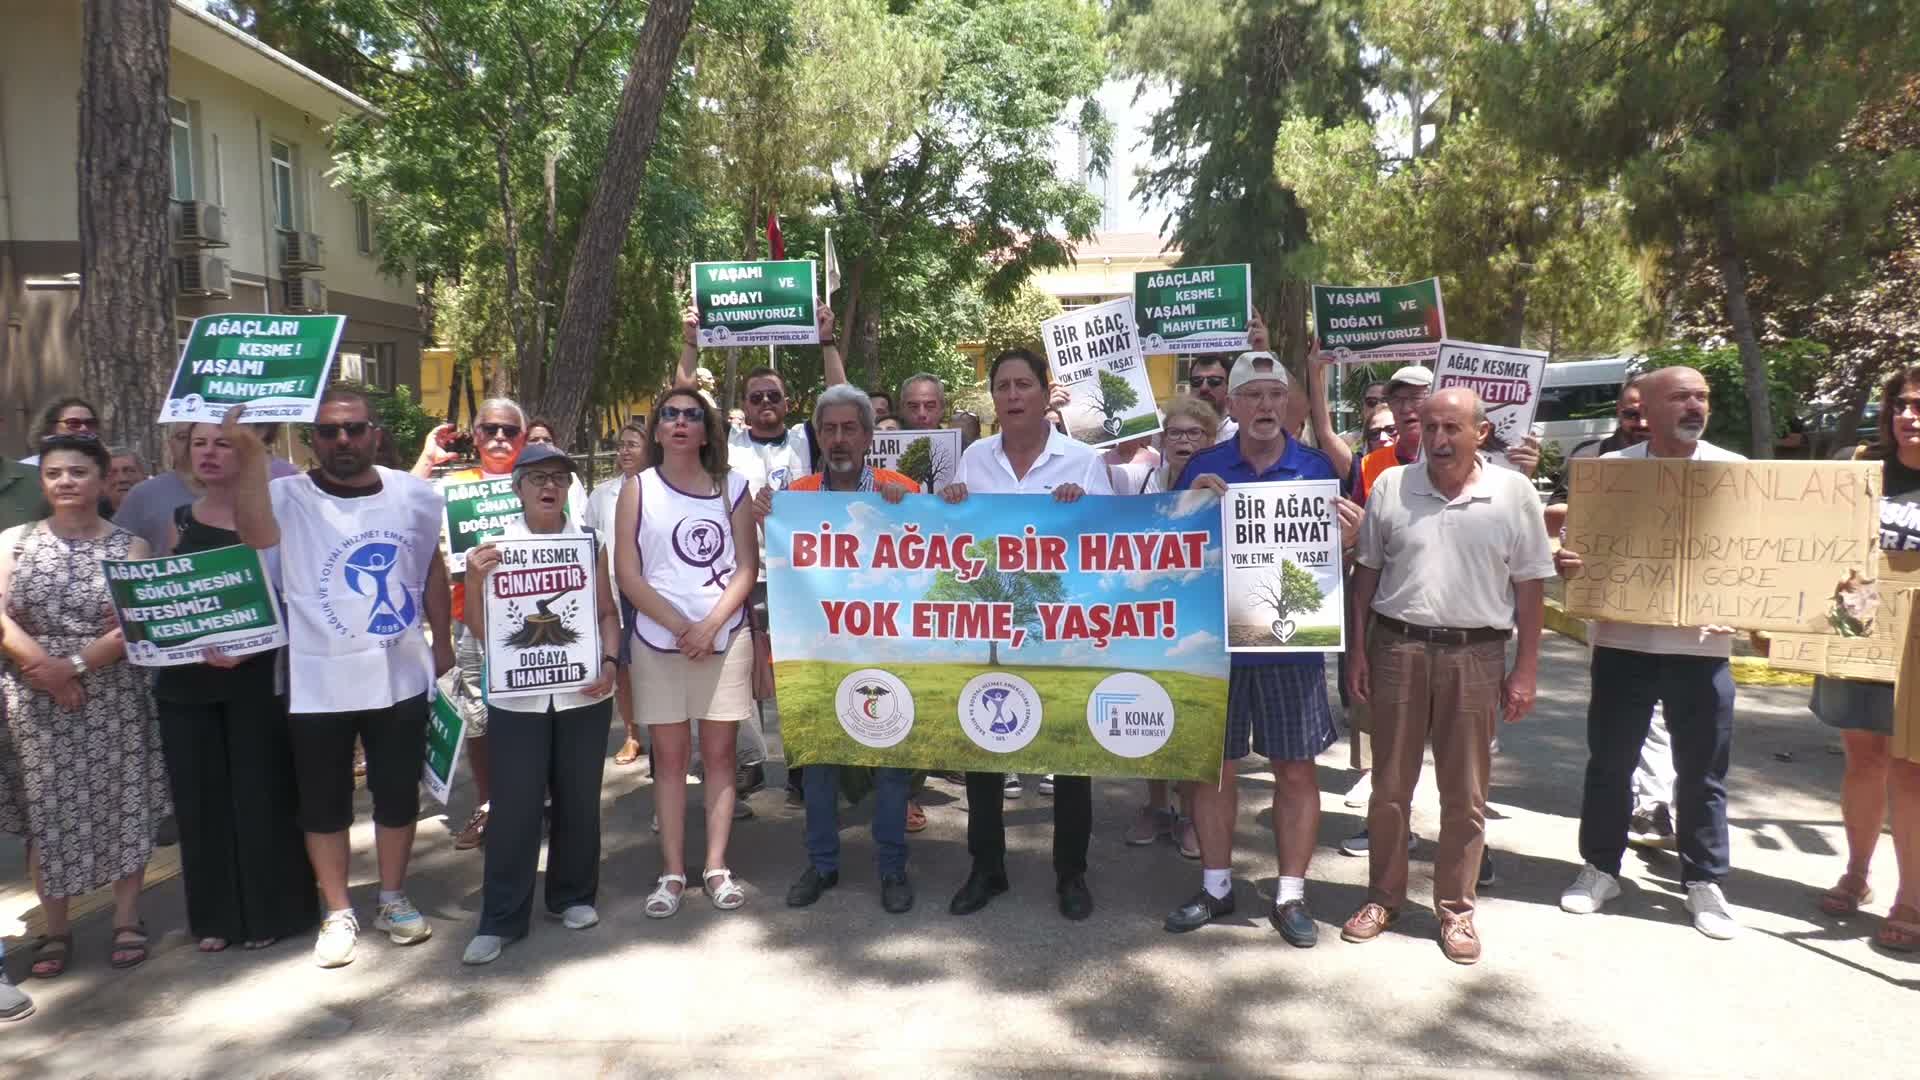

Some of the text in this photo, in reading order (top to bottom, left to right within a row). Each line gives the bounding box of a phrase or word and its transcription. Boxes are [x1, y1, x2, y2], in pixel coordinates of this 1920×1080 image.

[708, 266, 795, 288] YAŞAMI VE
[1147, 269, 1215, 289] AĞAÇLARI
[710, 291, 762, 306] DOĞAYI
[1175, 288, 1215, 301] KESME
[1327, 291, 1417, 311] YAŞAMI VE
[707, 308, 796, 322] SAVUNUYORUZ
[1145, 303, 1196, 320] YAŞAMI
[205, 319, 299, 338] AĞAÇLARI
[1053, 313, 1129, 347] BİR AĞAÇ,
[1163, 318, 1230, 333] MAHVETME
[1330, 315, 1383, 329] DOĞAYI
[1327, 327, 1422, 345] SAVUNUYORUZ
[238, 343, 294, 357] KESME
[1057, 332, 1131, 367] BİR HAYAT
[192, 360, 264, 376] YAŞAMI
[1447, 353, 1530, 378] AĞAÇ KESMEK
[1058, 367, 1093, 384] YOK ETME
[208, 380, 296, 396] MAHVETME
[1235, 493, 1330, 521] BİR AĞAÇ,
[1236, 520, 1331, 544] BİR HAYAT
[532, 547, 579, 564] KESMEK
[792, 522, 1210, 582] BİR AĞAÇ, BİR HAYAT
[1231, 551, 1329, 565] YOK ETME YAŞAT
[110, 558, 194, 581] AĞAÇLAR
[135, 572, 242, 601] SÖKÜLMESİN
[498, 566, 582, 595] CİNAYETTİR
[151, 608, 259, 638] KESİLMESİN!
[821, 600, 1177, 648] YOK ETME, YAŞAT!
[520, 649, 568, 667] DOĞAYA
[512, 663, 581, 687] İHANETTİR
[1125, 711, 1165, 726] KONAK
[1125, 728, 1166, 737] KENT KONSEYİ
